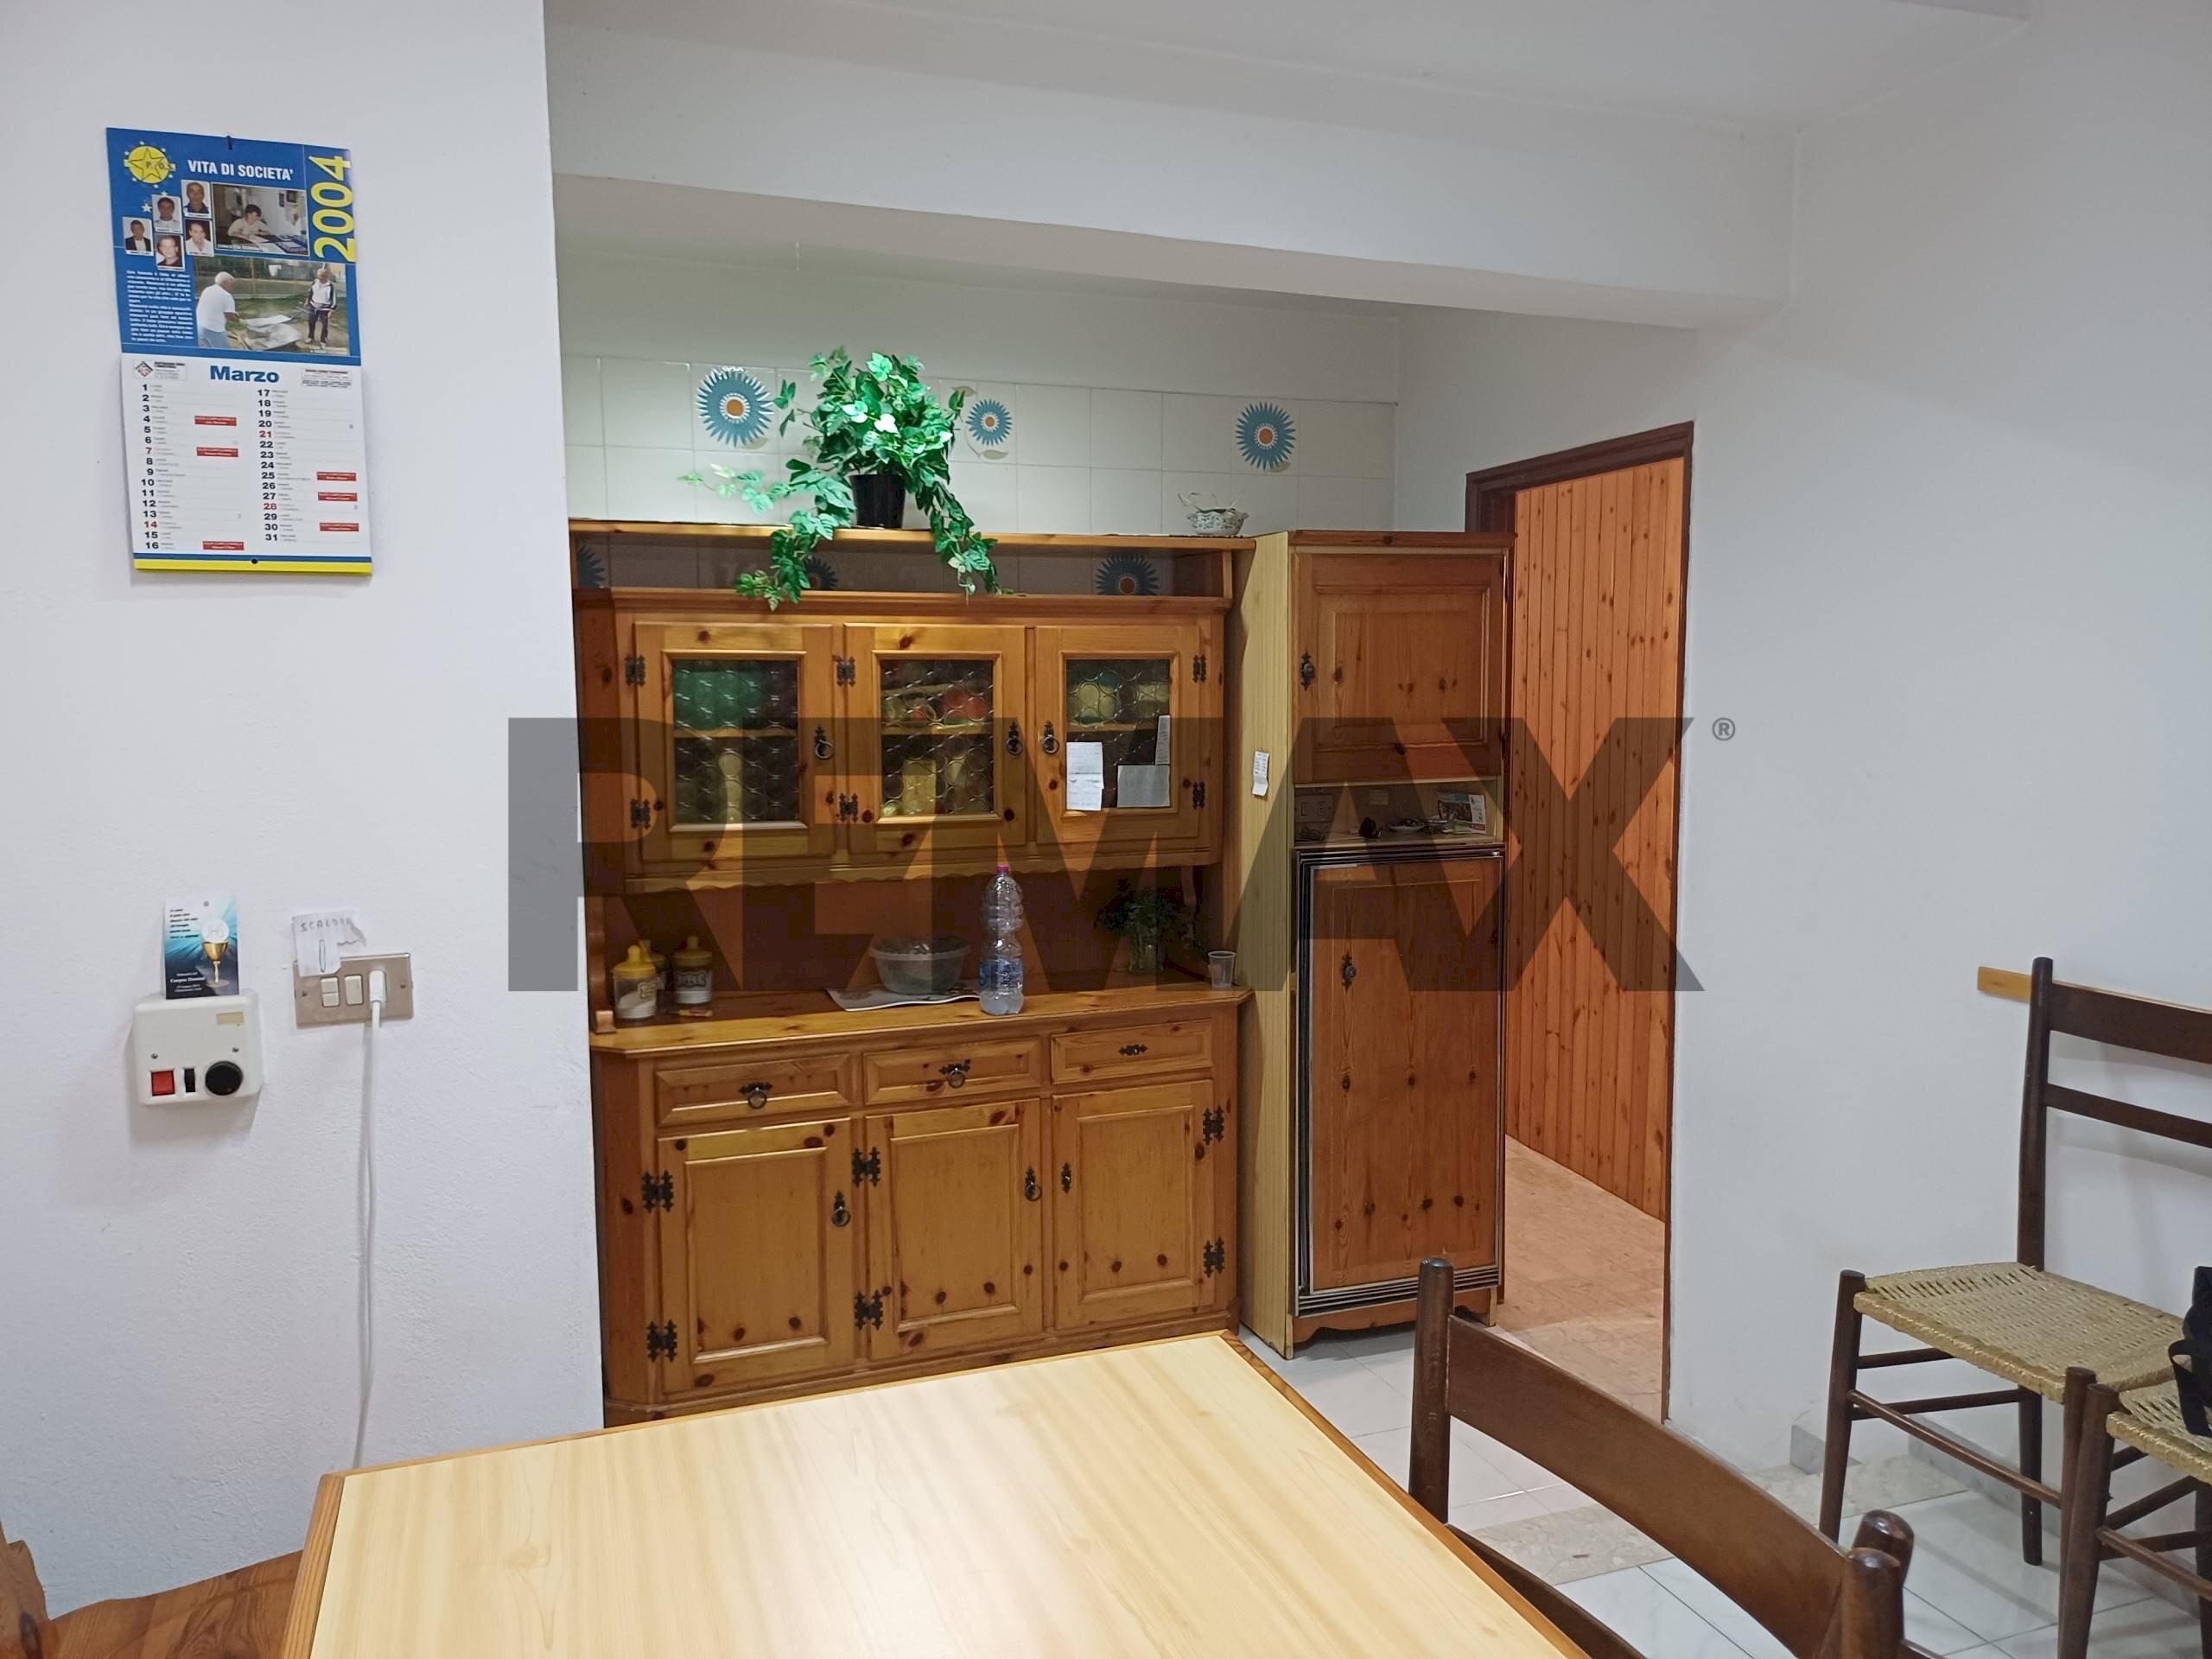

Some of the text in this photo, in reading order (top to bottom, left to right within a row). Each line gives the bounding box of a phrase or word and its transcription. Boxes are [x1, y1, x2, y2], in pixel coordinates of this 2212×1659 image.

[188, 159, 218, 175] VITA
[220, 162, 234, 176] DI
[238, 164, 294, 181] SOCIETA'
[308, 156, 356, 262] 2004
[210, 365, 279, 383] Marzo
[257, 389, 270, 397] 17
[143, 415, 151, 423] 4
[258, 419, 272, 428] 20
[143, 425, 151, 434] 5
[144, 435, 152, 444] 6
[259, 440, 274, 448] 22
[260, 450, 274, 459] 23
[146, 457, 153, 466] 8
[260, 461, 275, 469] 24
[146, 467, 154, 476] 9
[261, 471, 276, 480] 25
[141, 478, 155, 486] 10
[262, 481, 276, 490] 26
[262, 492, 276, 500] 27
[264, 502, 277, 511] 28
[143, 510, 157, 518] 13
[264, 512, 277, 521] 29
[264, 523, 278, 531] 30
[144, 531, 158, 539] 15
[264, 533, 277, 542] 31
